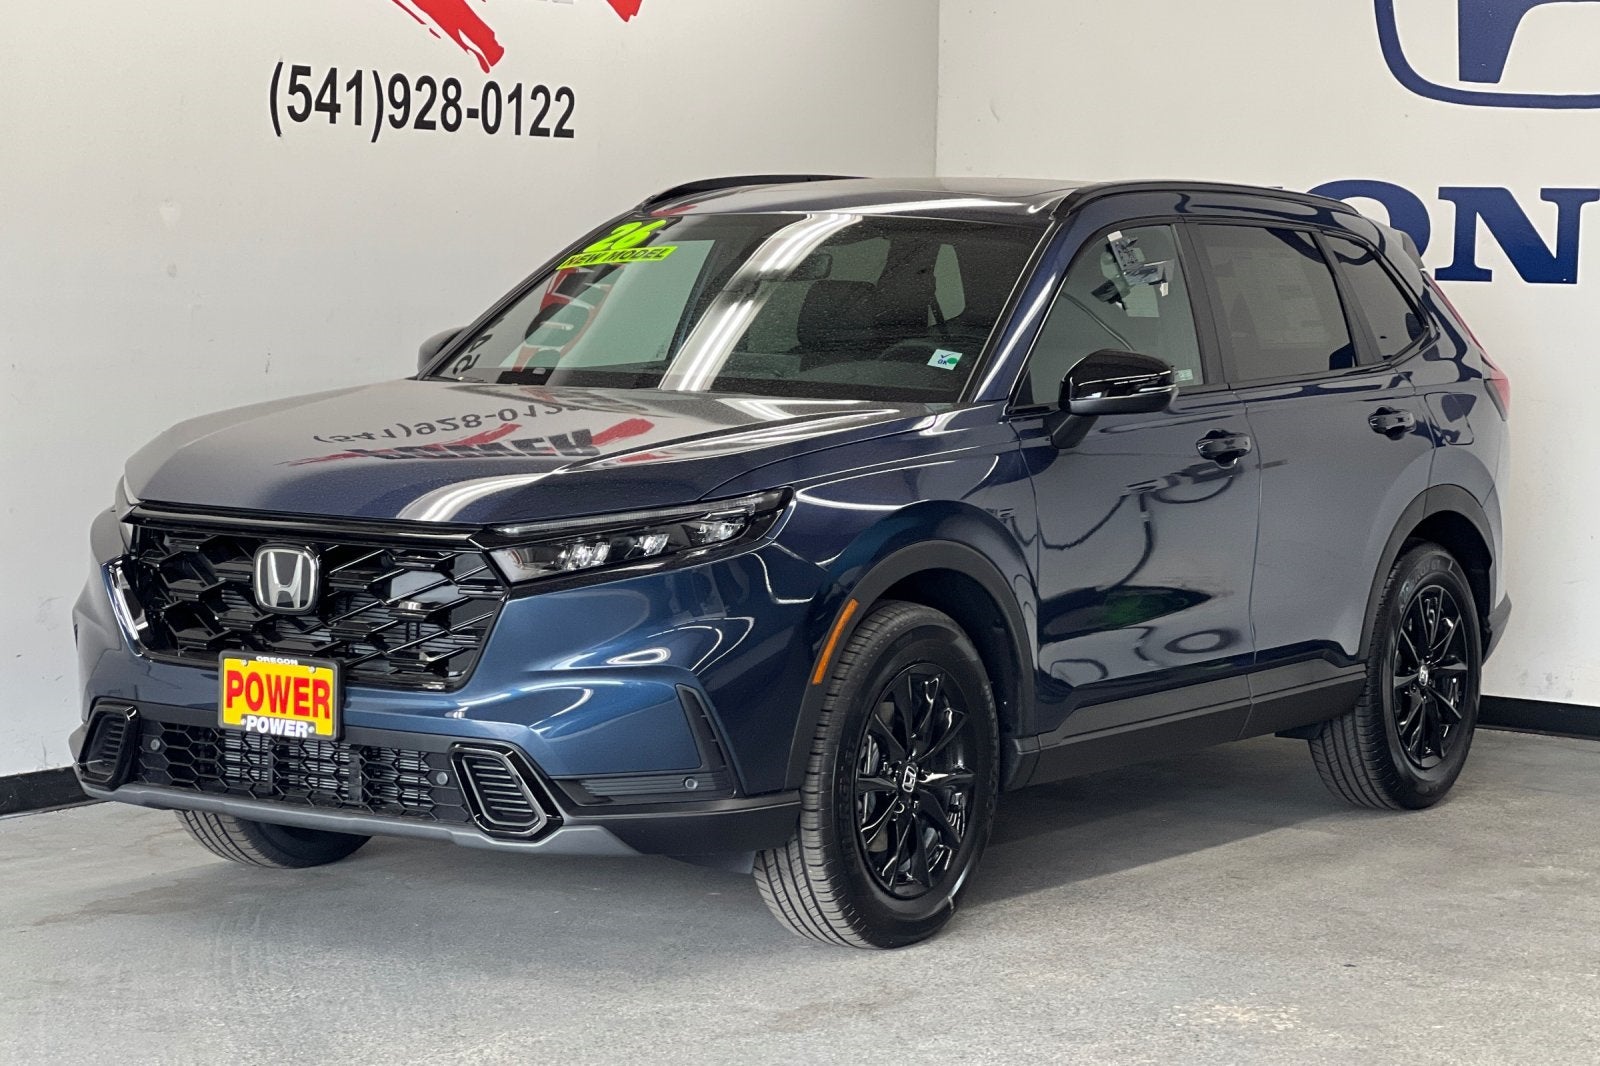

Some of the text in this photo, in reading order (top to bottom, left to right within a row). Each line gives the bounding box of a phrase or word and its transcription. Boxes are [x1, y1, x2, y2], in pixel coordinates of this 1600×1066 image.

[269, 61, 575, 143] (541)928-0122
[582, 219, 667, 253] 26
[1270, 179, 1600, 284] ON
[563, 247, 669, 266] NEW MODEL
[255, 655, 299, 666] OREGON
[226, 669, 331, 719] POWER
[245, 715, 308, 738] POWER
